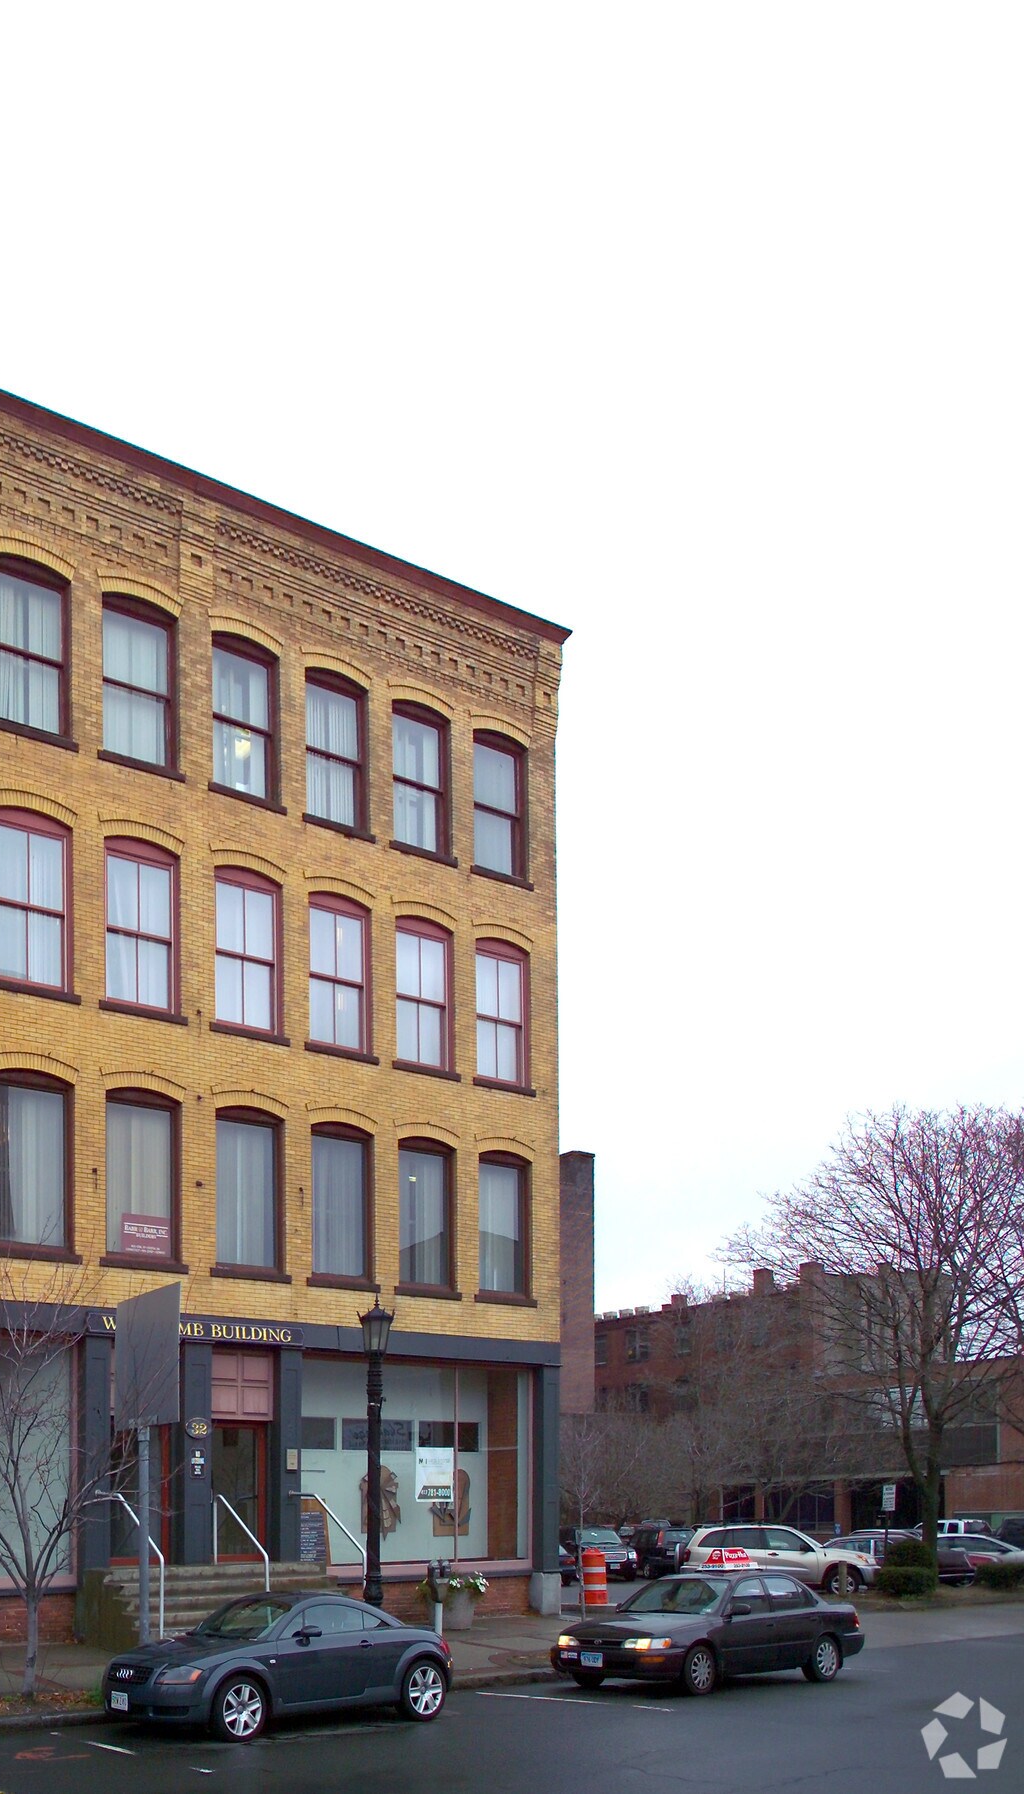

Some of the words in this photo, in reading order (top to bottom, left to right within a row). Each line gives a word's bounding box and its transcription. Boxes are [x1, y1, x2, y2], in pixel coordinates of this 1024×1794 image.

[210, 1323, 292, 1343] BUILDING
[191, 1422, 207, 1435] 32
[724, 1551, 738, 1559] Pizza
